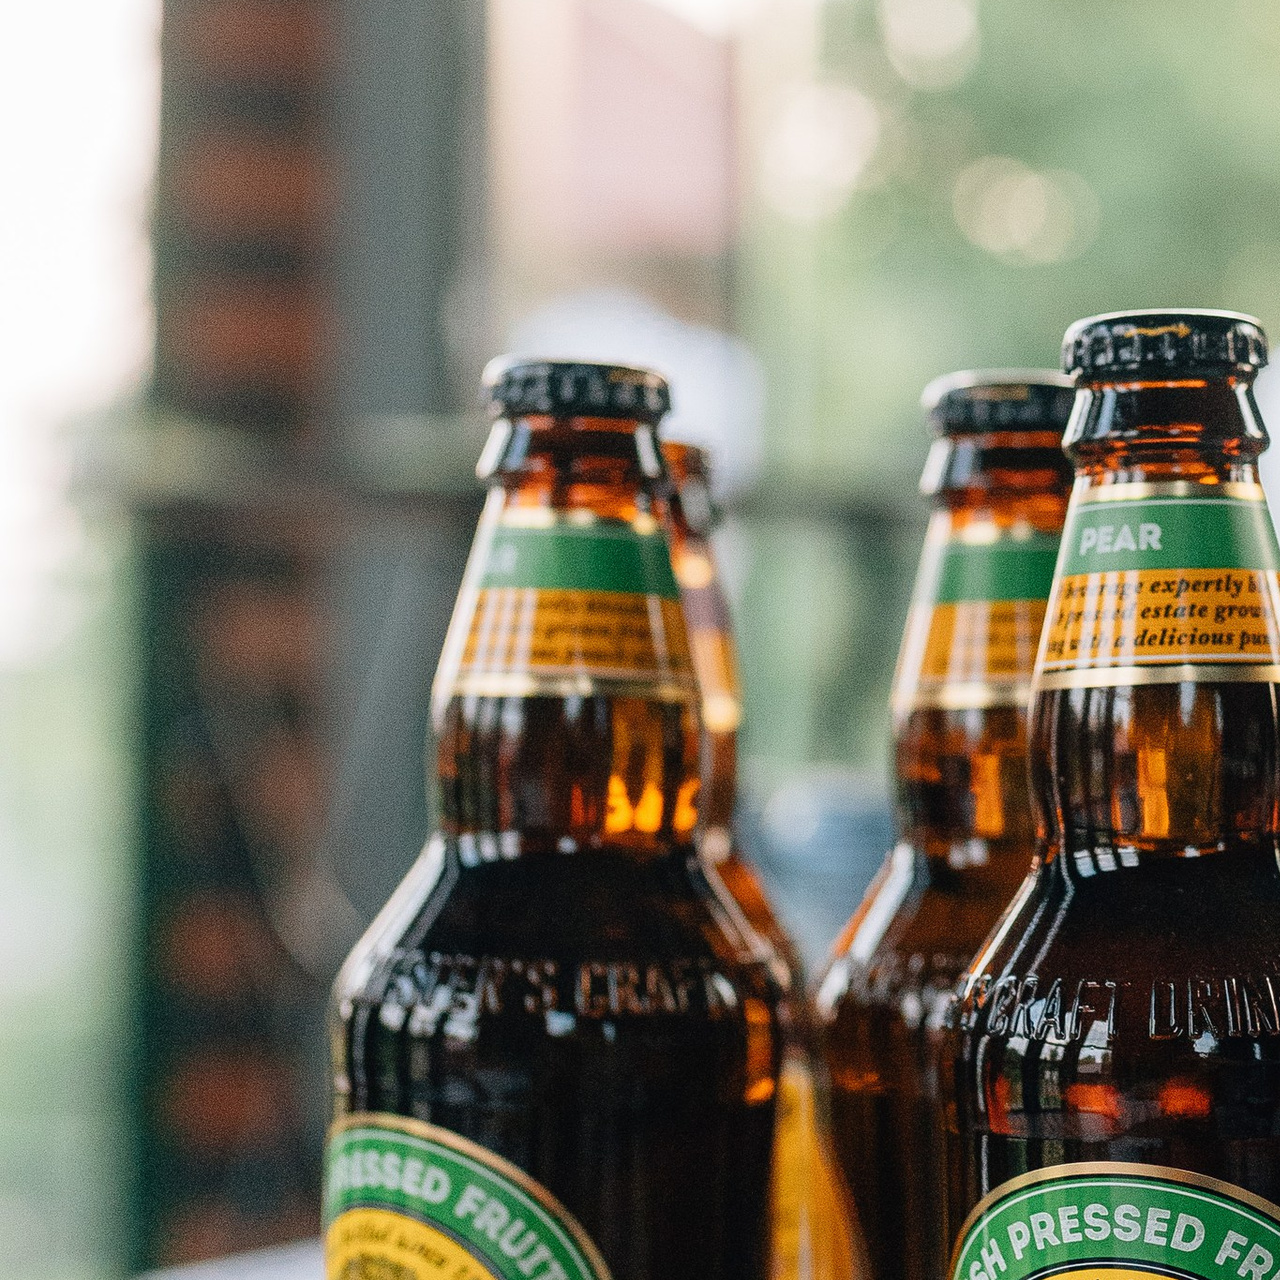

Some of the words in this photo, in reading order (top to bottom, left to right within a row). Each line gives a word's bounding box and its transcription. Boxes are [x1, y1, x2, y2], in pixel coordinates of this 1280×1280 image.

[1079, 522, 1162, 556] PEAR
[1150, 574, 1244, 599] expertly
[1140, 604, 1208, 619] estate
[1133, 626, 1235, 647] delicious
[1007, 1203, 1206, 1260] PRESSED
